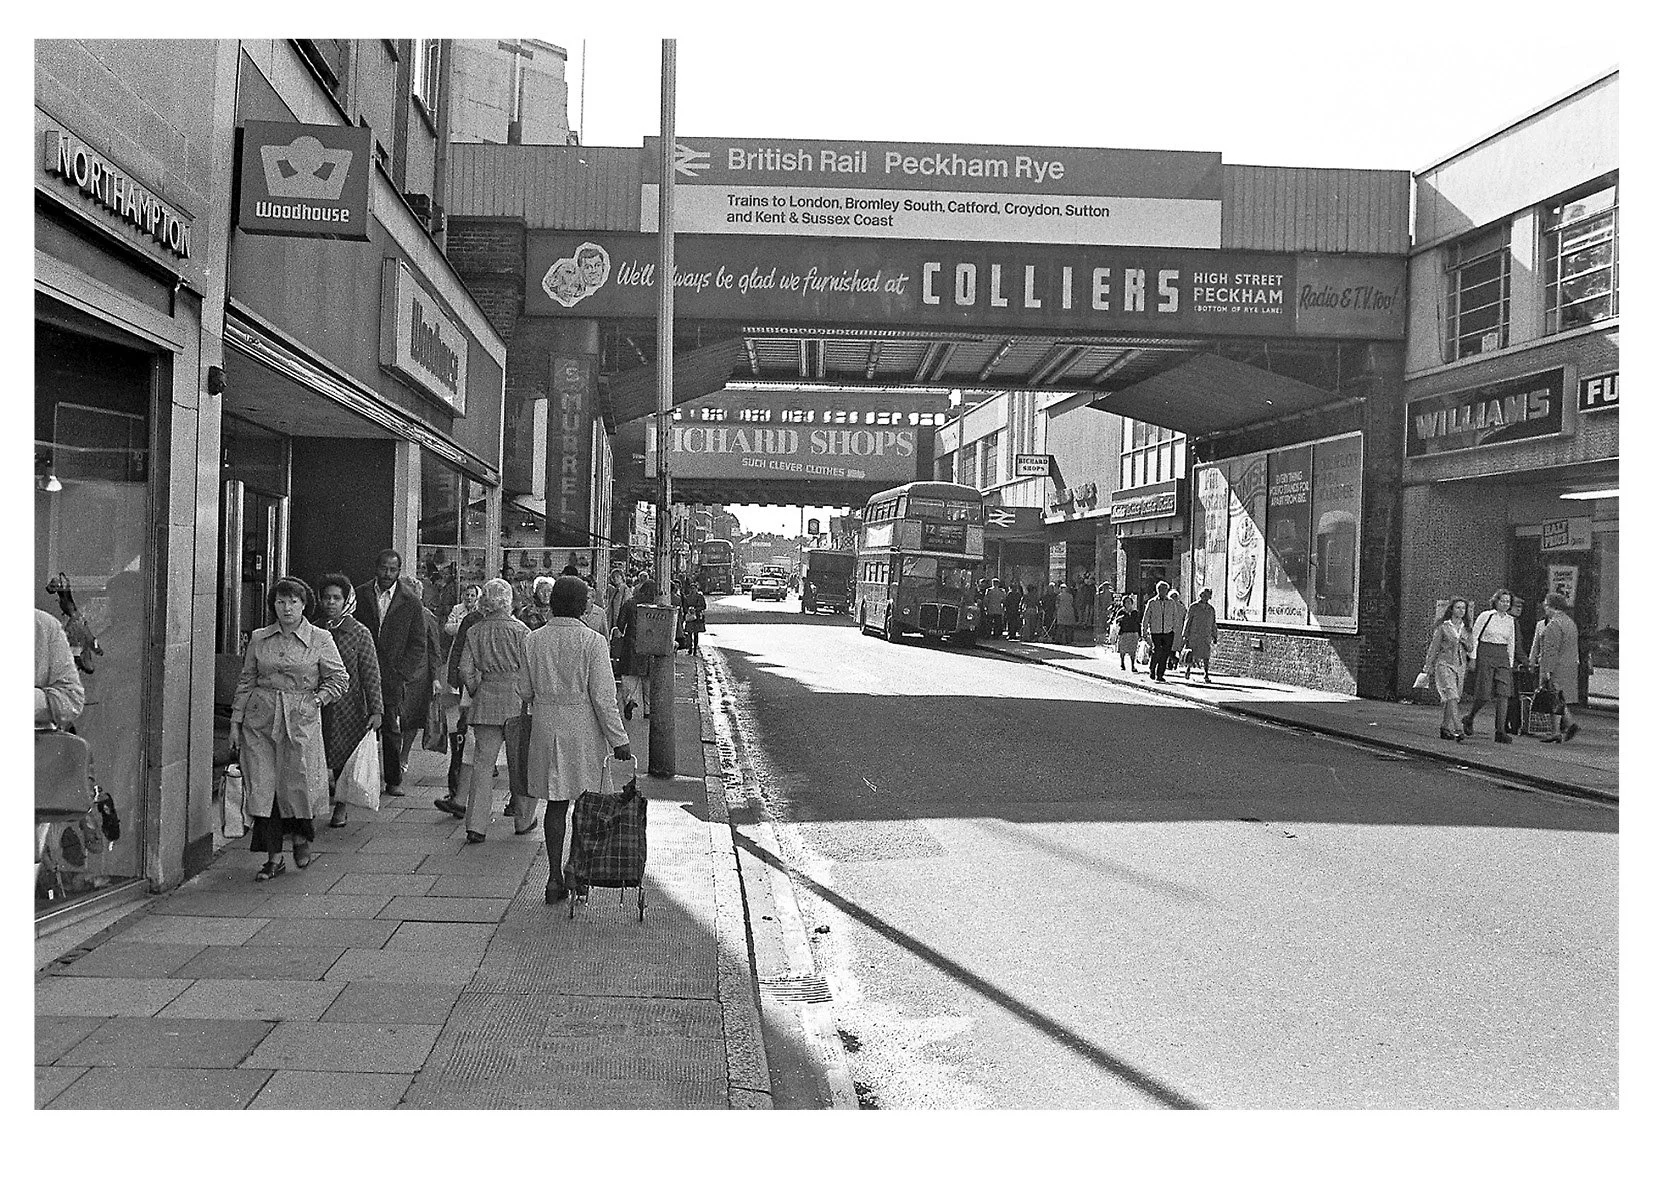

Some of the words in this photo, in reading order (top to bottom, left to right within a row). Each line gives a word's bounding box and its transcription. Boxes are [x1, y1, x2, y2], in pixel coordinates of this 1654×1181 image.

[728, 148, 813, 171] British
[820, 150, 867, 173] Rail
[885, 152, 1008, 179] Peckham
[1015, 156, 1065, 183] Rye
[57, 132, 191, 259] NORTHAMPTON
[727, 194, 768, 207] Trains
[772, 195, 786, 207] to
[845, 197, 899, 212] Bromley
[1065, 204, 1110, 218] Sutton
[255, 201, 350, 222] Woodhouse
[726, 211, 751, 222] and
[755, 212, 786, 223] Kent
[788, 212, 799, 223] &
[801, 213, 850, 224] Sussex
[853, 214, 893, 226] Coast
[671, 265, 712, 293] lways
[716, 266, 734, 289] be
[738, 267, 777, 294] glad
[780, 273, 800, 290] we
[803, 266, 881, 297] furnished
[884, 274, 909, 294] at
[922, 262, 1180, 313] COLLIERS
[1194, 272, 1228, 284] HIGH
[1235, 274, 1283, 286] STREET
[1193, 287, 1283, 304] PECKHAM
[1300, 284, 1338, 310] Radio
[1587, 376, 1618, 405] FU
[1415, 388, 1550, 439] WILLIAMS
[645, 427, 798, 454] ICHARD
[810, 430, 914, 456] SHOPS
[742, 458, 766, 468] SUCH
[769, 460, 803, 471] CLEVER
[805, 464, 845, 476] CLOTHES
